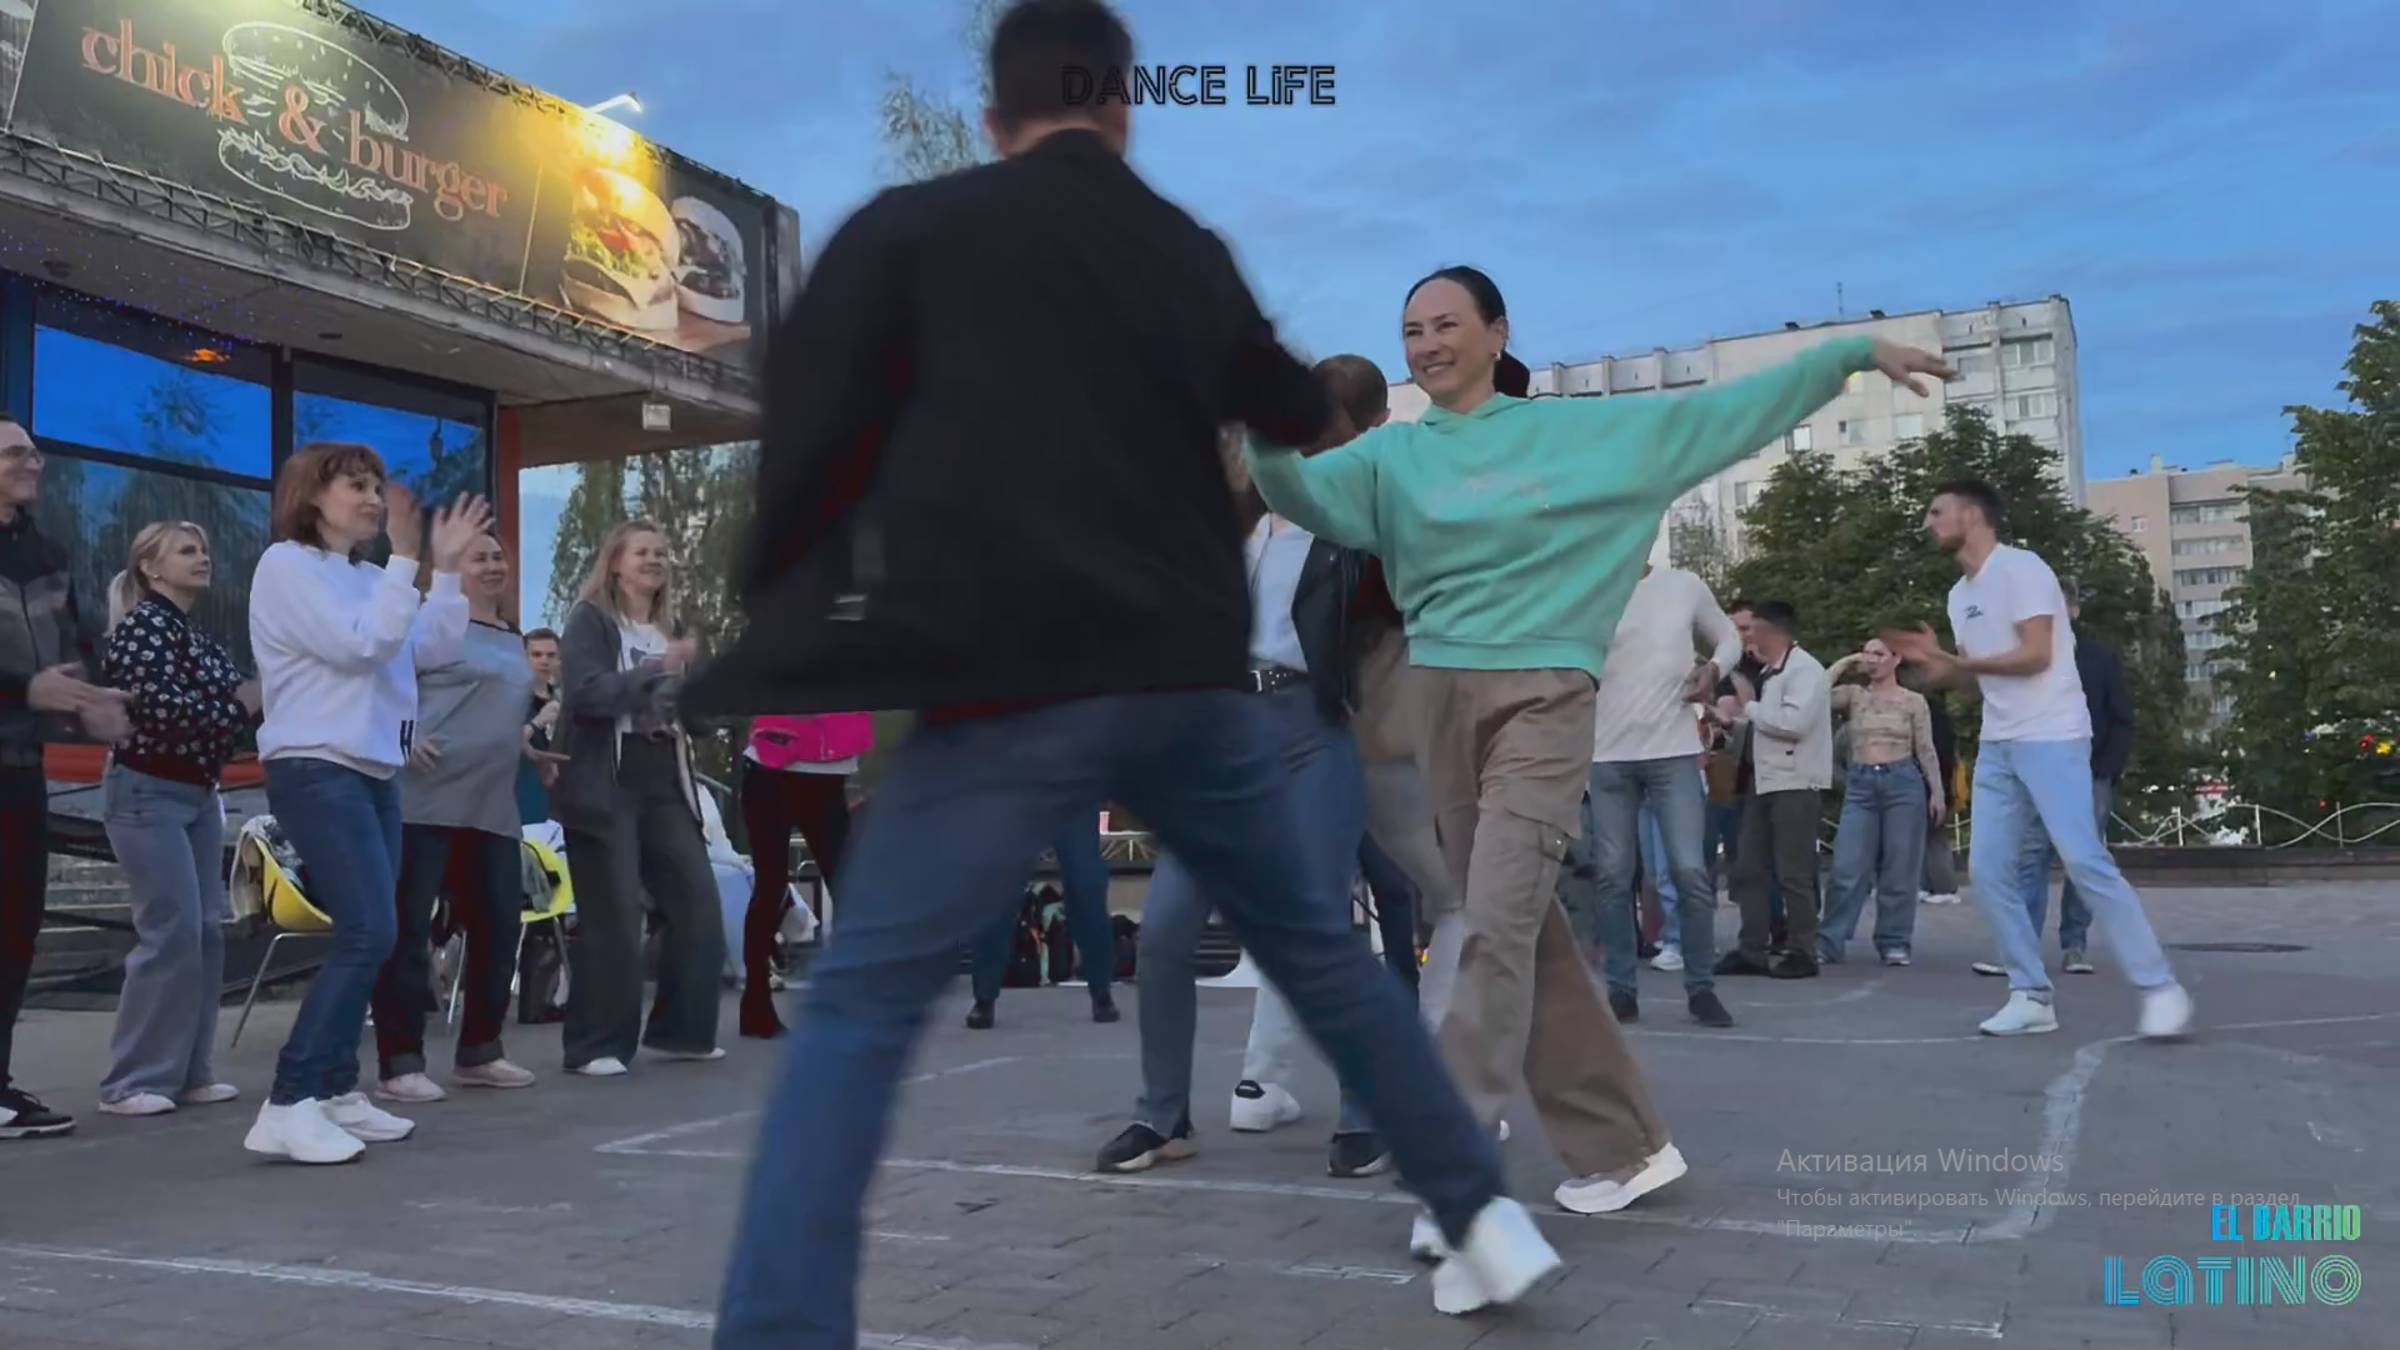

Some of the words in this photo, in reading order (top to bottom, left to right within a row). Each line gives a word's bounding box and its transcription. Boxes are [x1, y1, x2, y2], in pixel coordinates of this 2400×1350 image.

[81, 19, 249, 126] chick
[278, 84, 329, 156] &
[349, 110, 508, 222] burger
